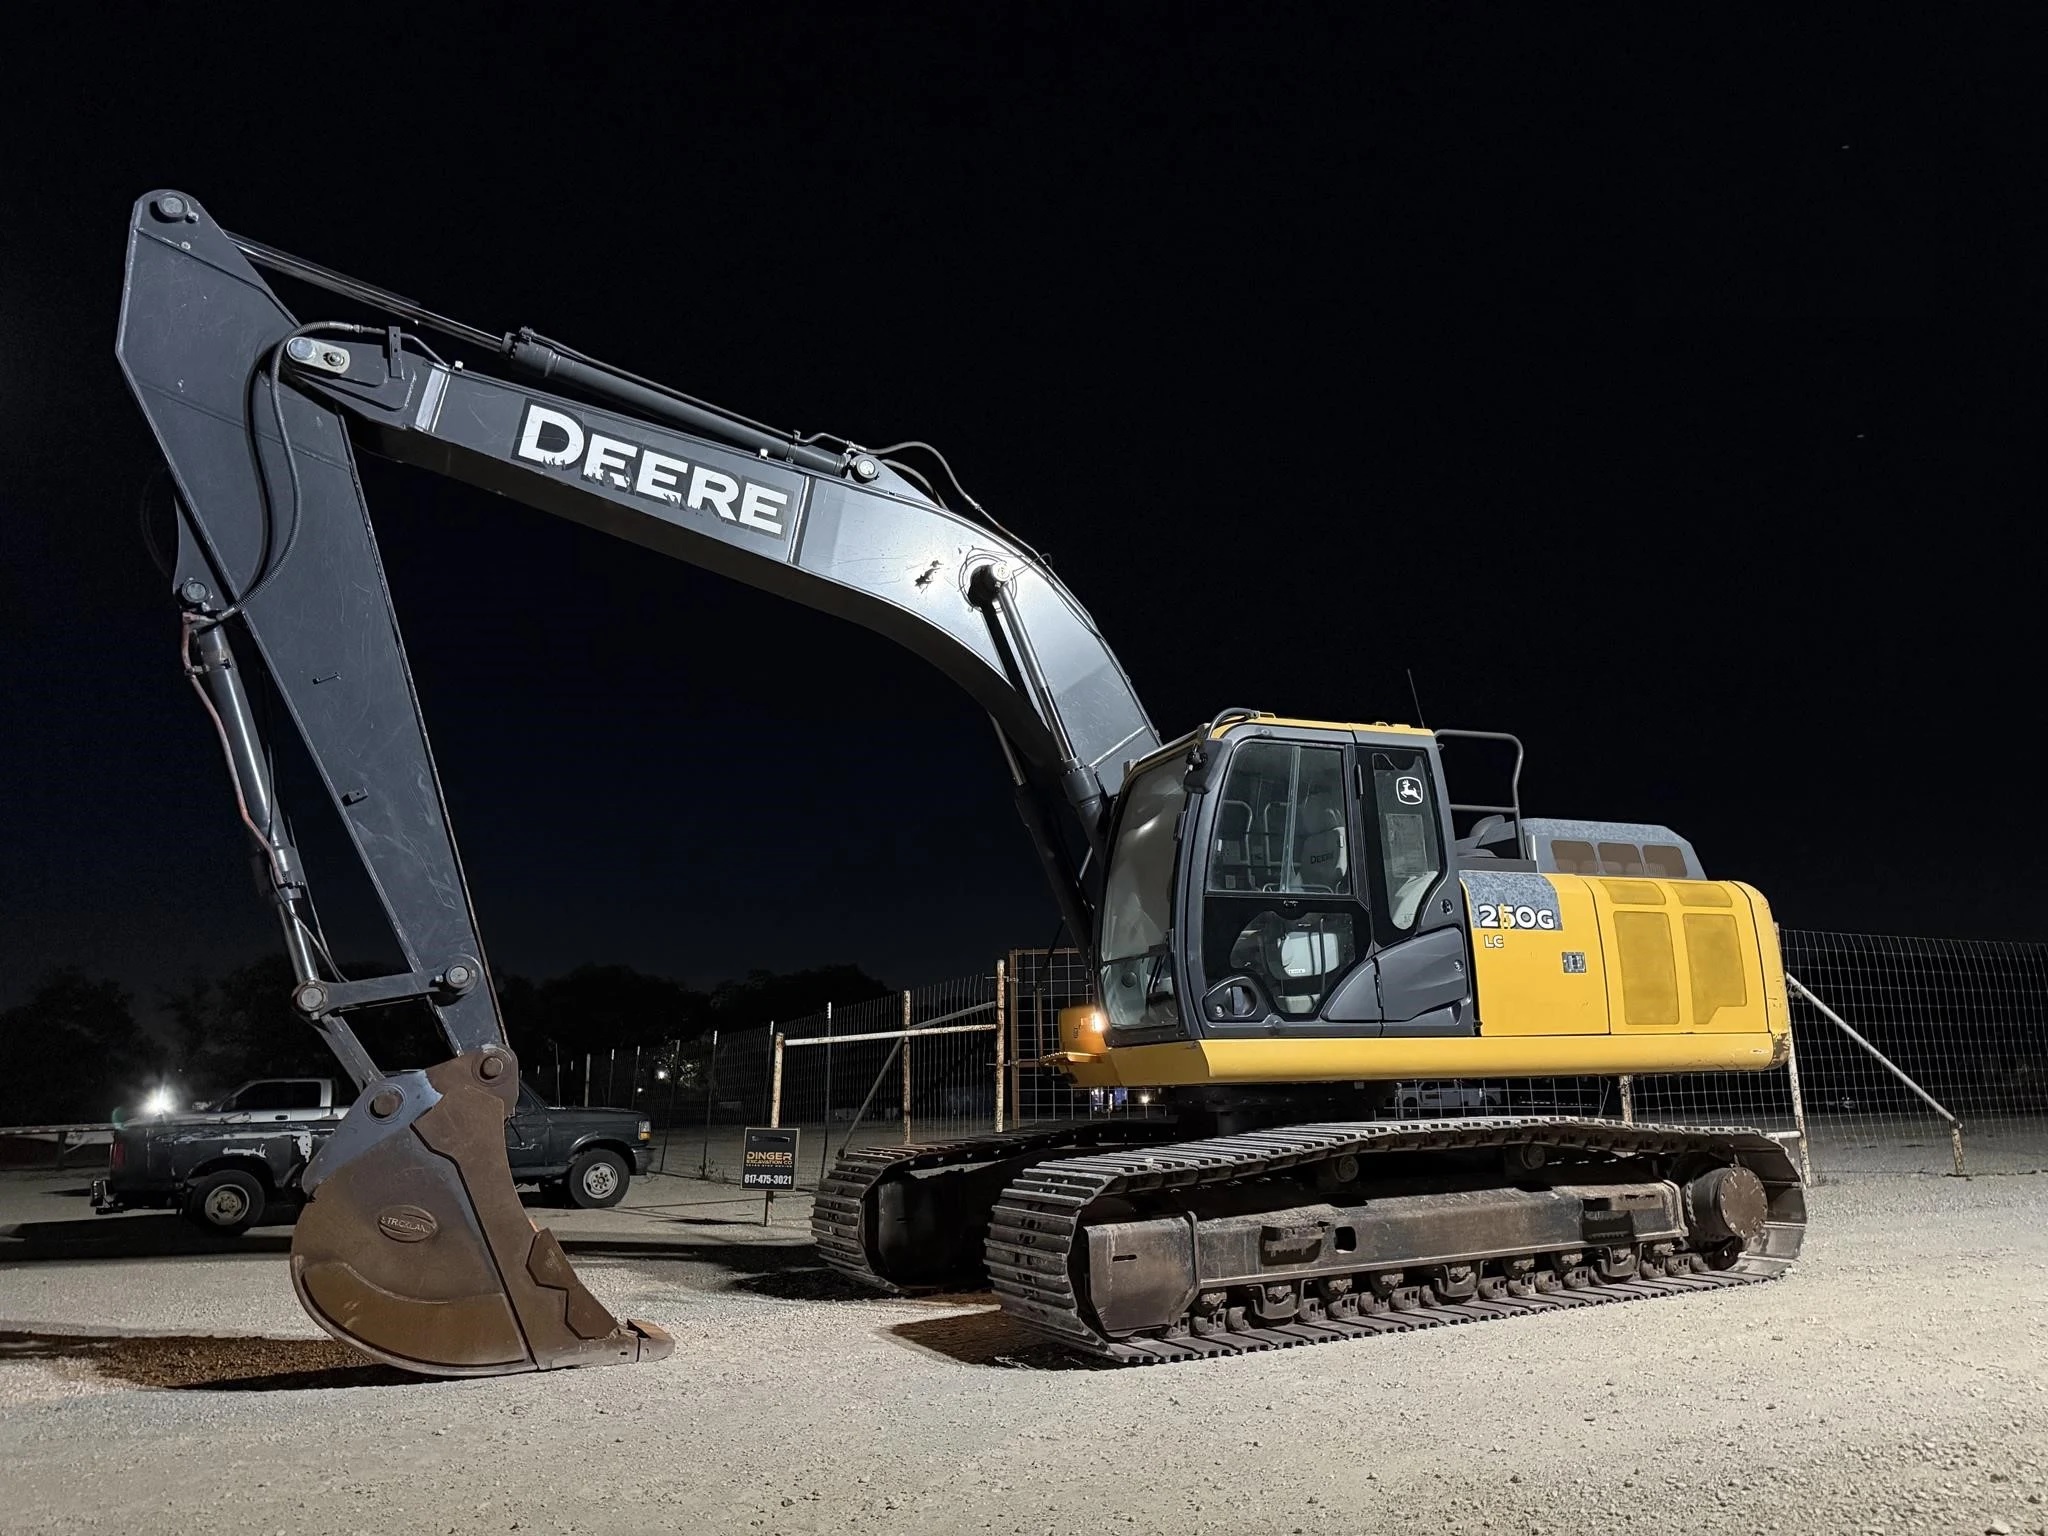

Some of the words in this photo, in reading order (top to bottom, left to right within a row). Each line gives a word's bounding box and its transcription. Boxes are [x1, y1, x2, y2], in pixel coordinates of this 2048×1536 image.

[518, 404, 788, 535] DEERE
[1478, 904, 1556, 930] 250G
[1484, 935, 1504, 948] LC
[746, 1151, 793, 1161] DINGER
[744, 1174, 792, 1185] 817-475-3021
